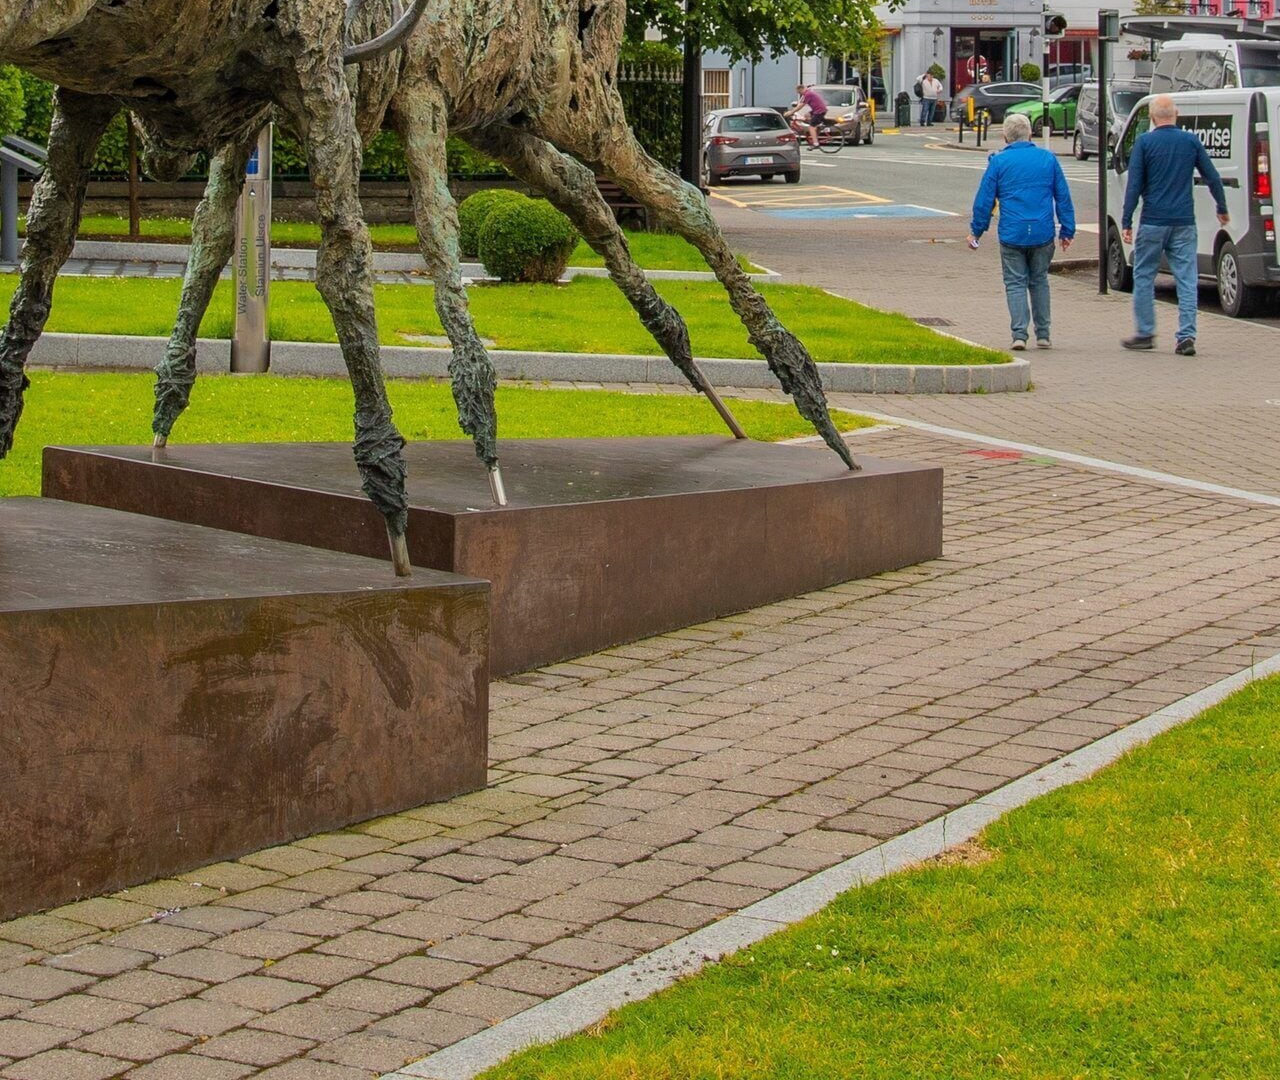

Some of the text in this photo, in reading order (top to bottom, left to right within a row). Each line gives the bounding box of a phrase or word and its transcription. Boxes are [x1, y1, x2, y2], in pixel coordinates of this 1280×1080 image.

[255, 214, 265, 248] Uisce
[237, 237, 248, 314] Water Station
